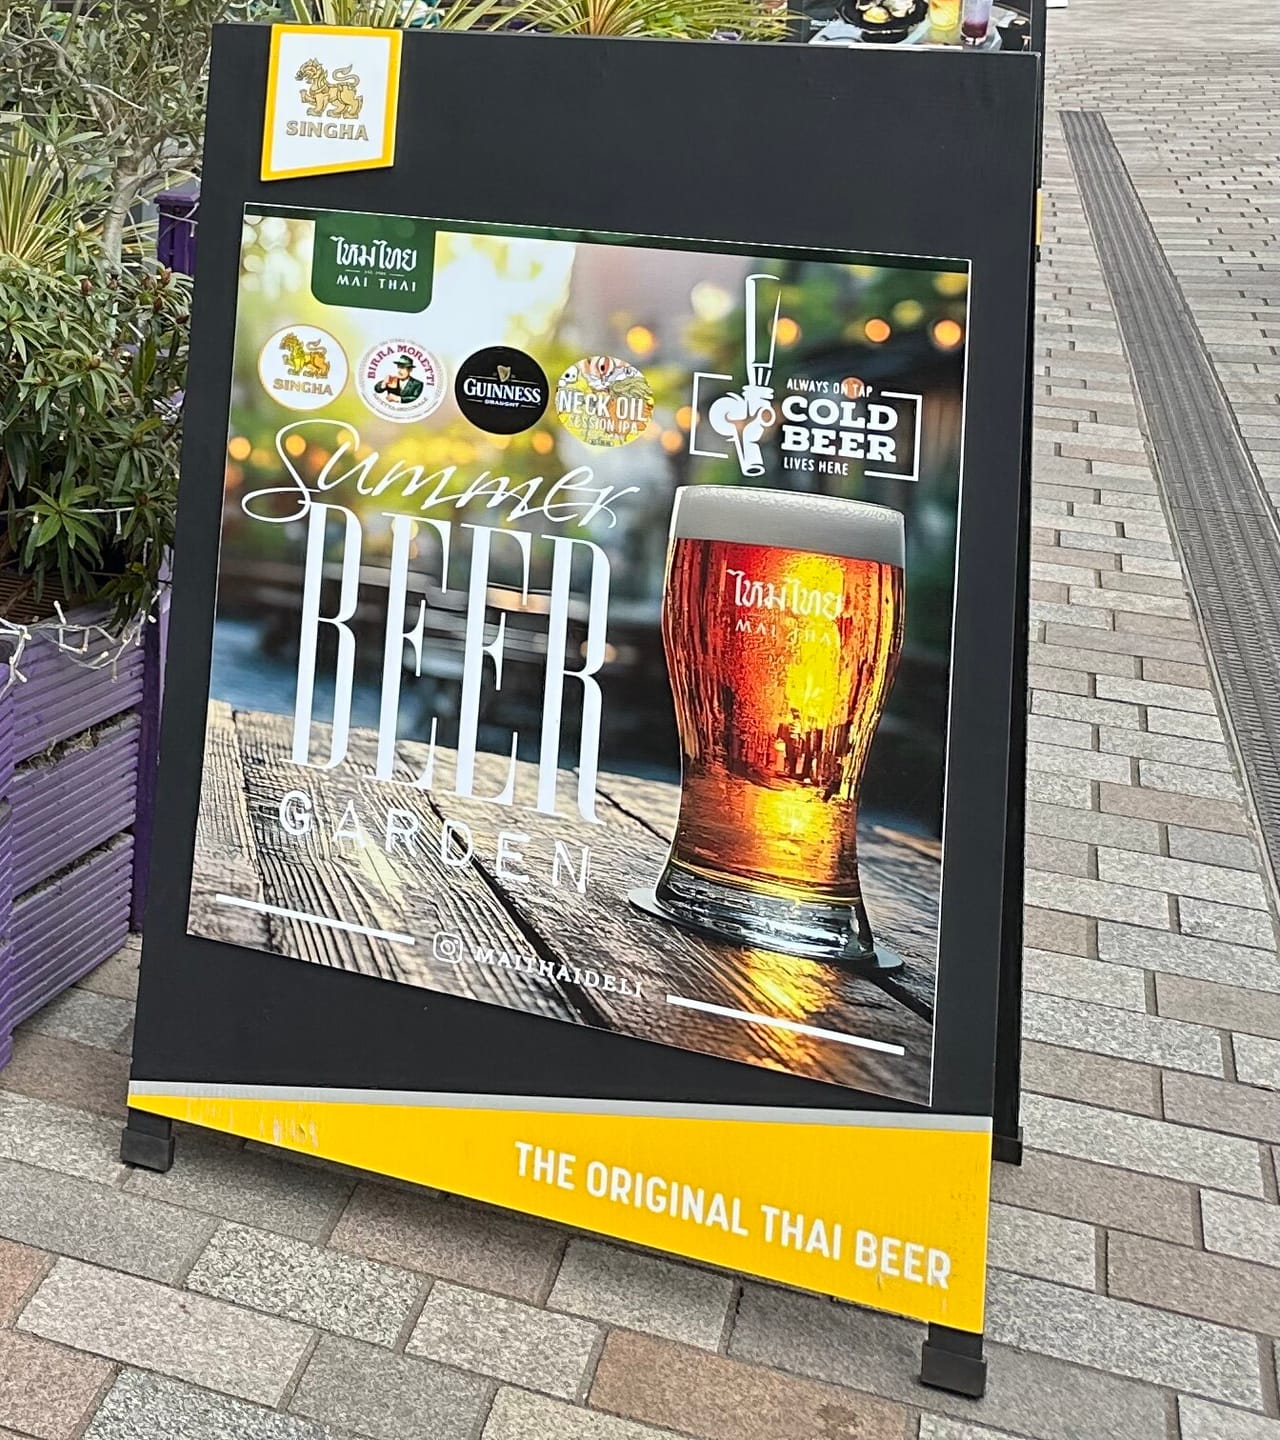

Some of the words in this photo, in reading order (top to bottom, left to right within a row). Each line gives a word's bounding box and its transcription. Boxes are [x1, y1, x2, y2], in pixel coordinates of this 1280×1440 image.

[286, 120, 369, 141] SINGHA
[336, 274, 368, 288] MAI
[378, 278, 416, 292] THAI
[367, 346, 395, 379] BIRRA
[397, 344, 435, 387] MORETTI
[273, 377, 334, 396] SINGHA
[463, 379, 541, 405] GUINNESS
[786, 378, 830, 394] ALWAYS
[833, 382, 848, 396] ON
[853, 384, 874, 398] TAP
[558, 391, 611, 418] NECK
[616, 396, 648, 422] OIL
[781, 395, 898, 431] COLD
[568, 414, 615, 433] SESSION
[619, 420, 639, 434] IPA
[781, 425, 897, 462] BEER
[783, 456, 815, 472] LIVES
[818, 461, 849, 476] HERE
[280, 500, 611, 826] BEER
[279, 790, 594, 895] GARDEN
[474, 946, 642, 998] MAITHAIDELI
[515, 1141, 576, 1191] THE
[585, 1160, 749, 1237] ORIGINAL
[761, 1203, 842, 1261] THAI
[855, 1228, 953, 1290] BEER
